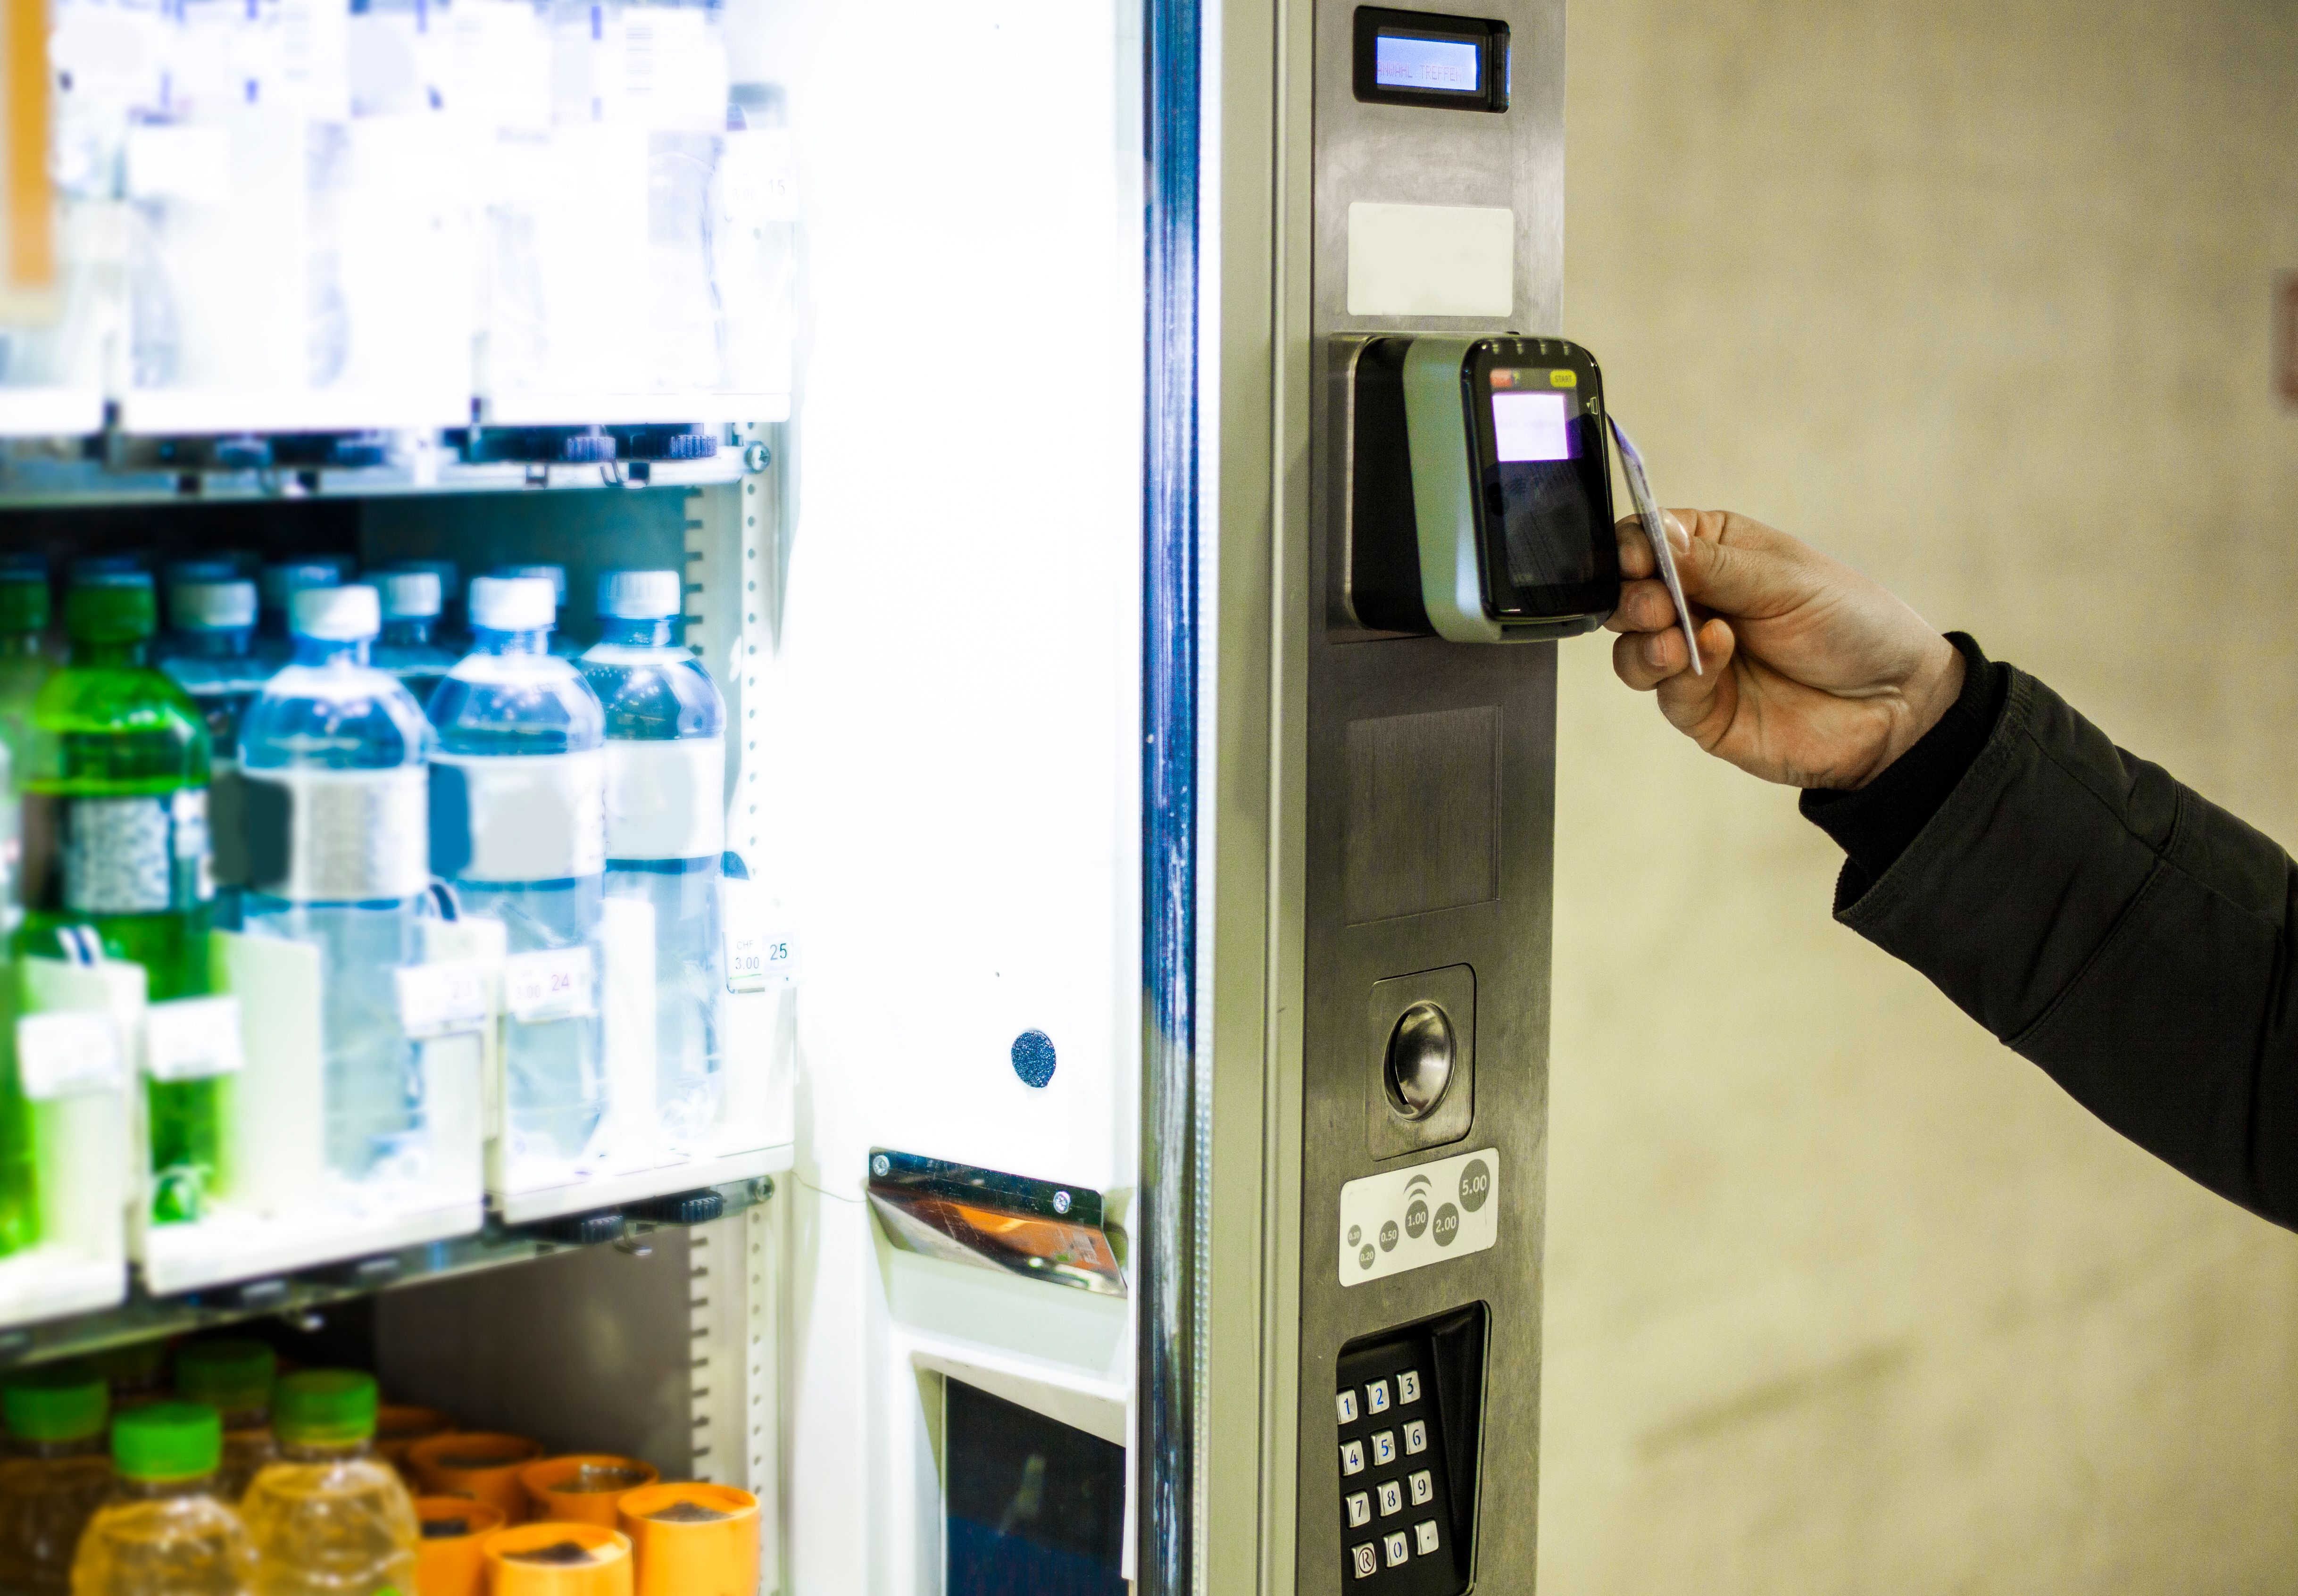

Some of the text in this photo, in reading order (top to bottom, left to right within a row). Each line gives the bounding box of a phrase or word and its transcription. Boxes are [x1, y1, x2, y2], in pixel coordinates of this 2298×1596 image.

[1420, 65, 1462, 81] TREFFEN
[732, 188, 756, 201] 300
[768, 179, 786, 196] 15
[737, 940, 754, 950] CHF
[770, 943, 787, 961] 25
[452, 980, 473, 998] 23
[551, 973, 570, 991] 24
[516, 985, 541, 1000] 300
[1462, 1175, 1487, 1196] 5.00
[1408, 1211, 1426, 1227] 1.00
[1436, 1215, 1457, 1233] 2.00
[1349, 1231, 1360, 1240] 0.10
[1381, 1230, 1397, 1242] 0.50
[1360, 1251, 1374, 1262] 0.20
[1344, 1377, 1414, 1415] 1 2 3
[1350, 1429, 1421, 1466] 4 5 6
[1356, 1479, 1426, 1518] 7 8 9
[1393, 1541, 1402, 1558] 0
